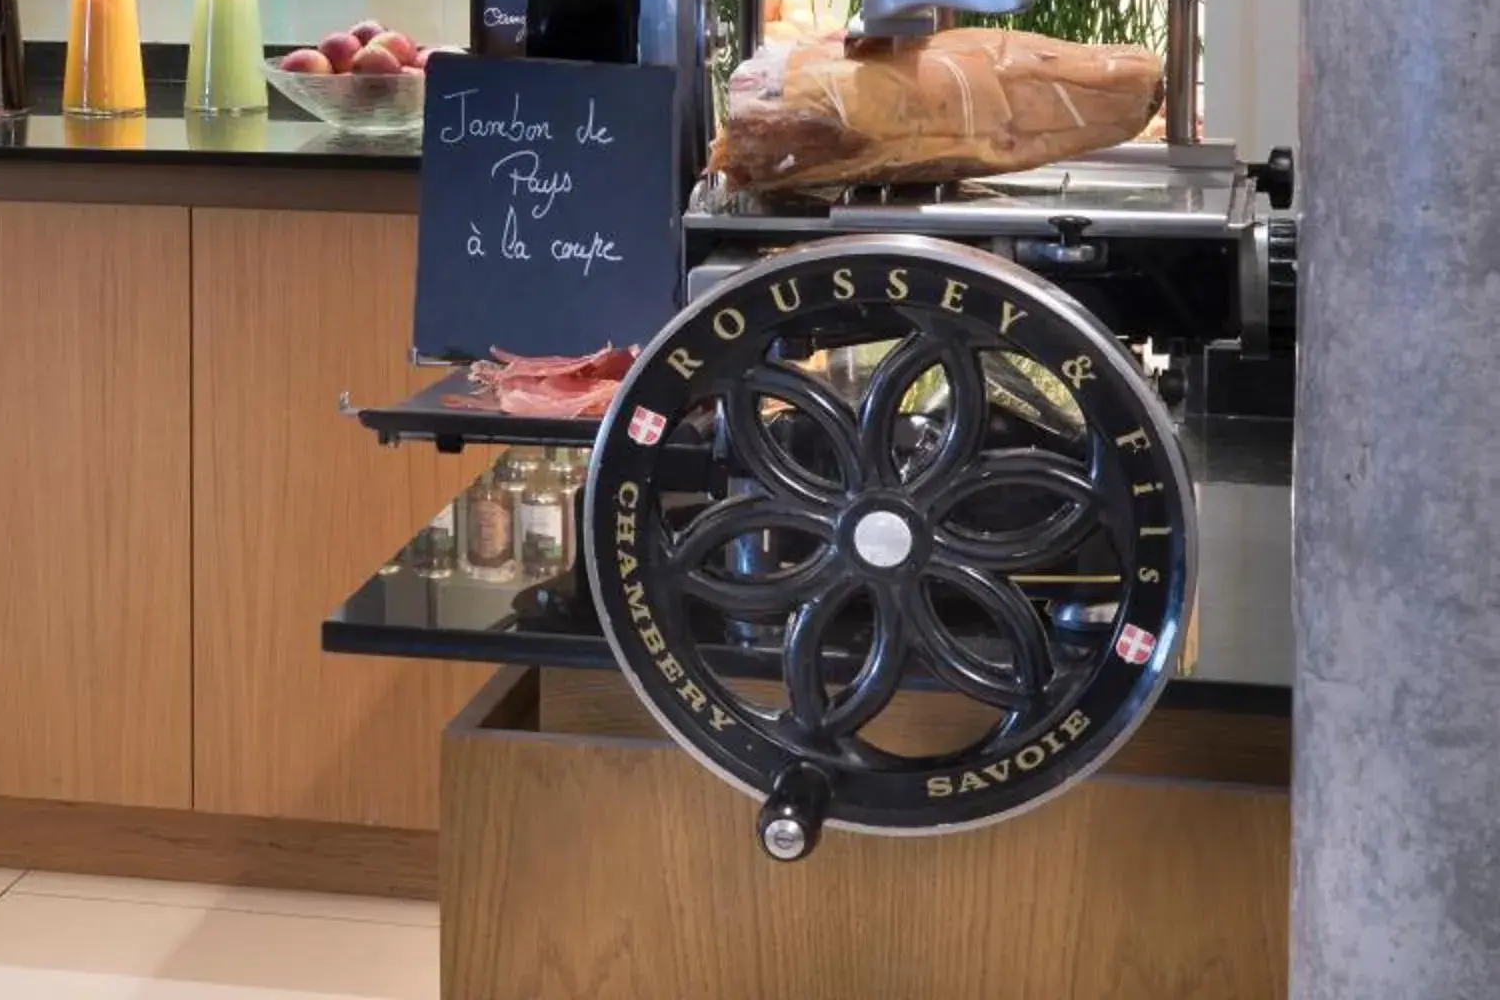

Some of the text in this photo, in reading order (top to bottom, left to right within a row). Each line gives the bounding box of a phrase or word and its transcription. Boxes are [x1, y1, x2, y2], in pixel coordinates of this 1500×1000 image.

[440, 88, 614, 144] Jambon de
[491, 150, 573, 218] Pays
[466, 205, 623, 276] à la coupe
[667, 267, 1173, 586] ROUSSEY & Fils
[614, 481, 737, 732] CHAMBERY
[926, 710, 1091, 799] SAVOIE
